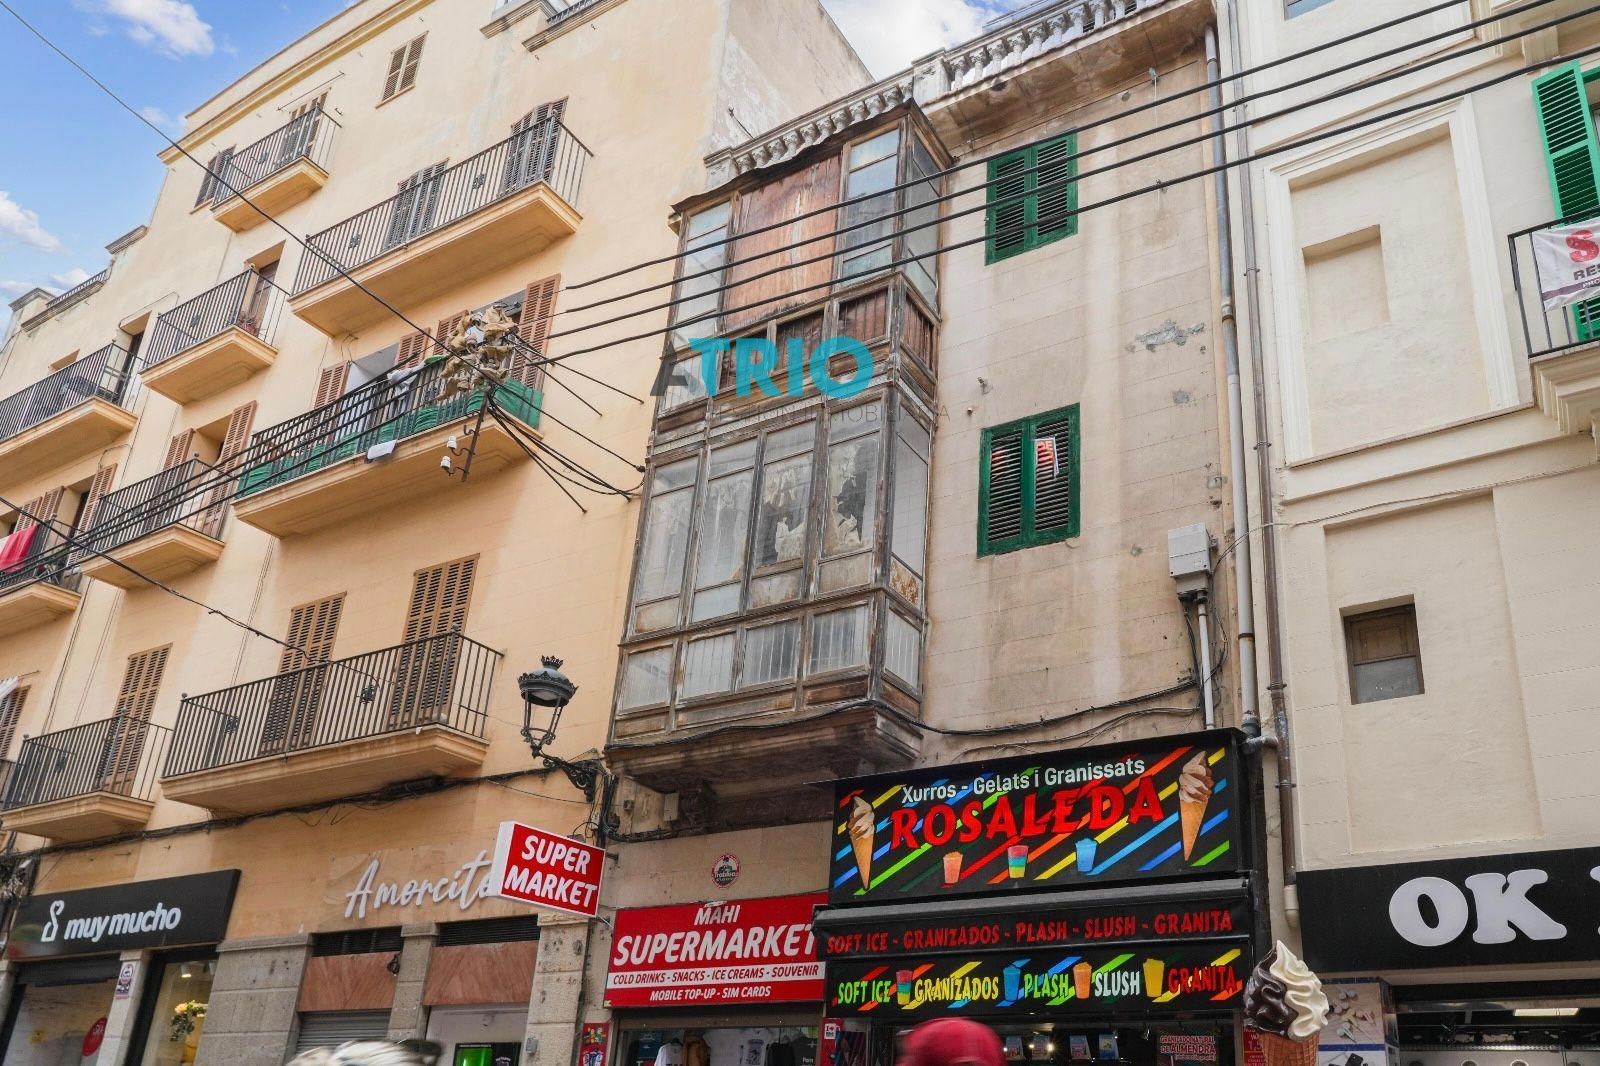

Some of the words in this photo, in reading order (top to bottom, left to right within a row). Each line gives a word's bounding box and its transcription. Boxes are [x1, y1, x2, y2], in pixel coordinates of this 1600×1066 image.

[901, 783, 957, 805] Xurros
[973, 769, 1030, 795] Gelats
[1034, 769, 1039, 787] i
[1044, 757, 1146, 787] Granissats
[890, 775, 1165, 851] ROSALEDA
[521, 834, 591, 876] SUPER
[504, 864, 598, 908] MARKET
[1388, 868, 1568, 947] OK
[694, 904, 741, 926] MAHI
[827, 932, 862, 954] SOFT
[866, 931, 888, 951] ICE
[903, 925, 1000, 950] GRANIZADOS
[1015, 920, 1069, 943] PLASH
[1084, 916, 1136, 939] SLUSH
[1154, 910, 1233, 935] GRANITA
[613, 923, 815, 967] SUPERMARKET
[613, 972, 635, 985] COLD
[635, 971, 665, 984] DRINKS
[671, 969, 705, 983] SNACKS
[711, 968, 726, 980] ICE
[727, 966, 764, 980] CREAMS
[771, 964, 819, 978] SOUVENIR
[650, 989, 683, 1001] MOBILE
[684, 987, 716, 999] TOP-UP
[722, 986, 740, 998] SIM
[741, 985, 771, 997] CARDS
[837, 981, 868, 1003] SOFT
[871, 980, 892, 1003] ICE
[914, 973, 999, 1002] GRANIZADOS
[1023, 973, 1070, 999] PLASH
[1094, 970, 1141, 997] SLUSH
[1168, 964, 1237, 994] GRANITA
[1170, 1043, 1216, 1054] ALMENDRA
